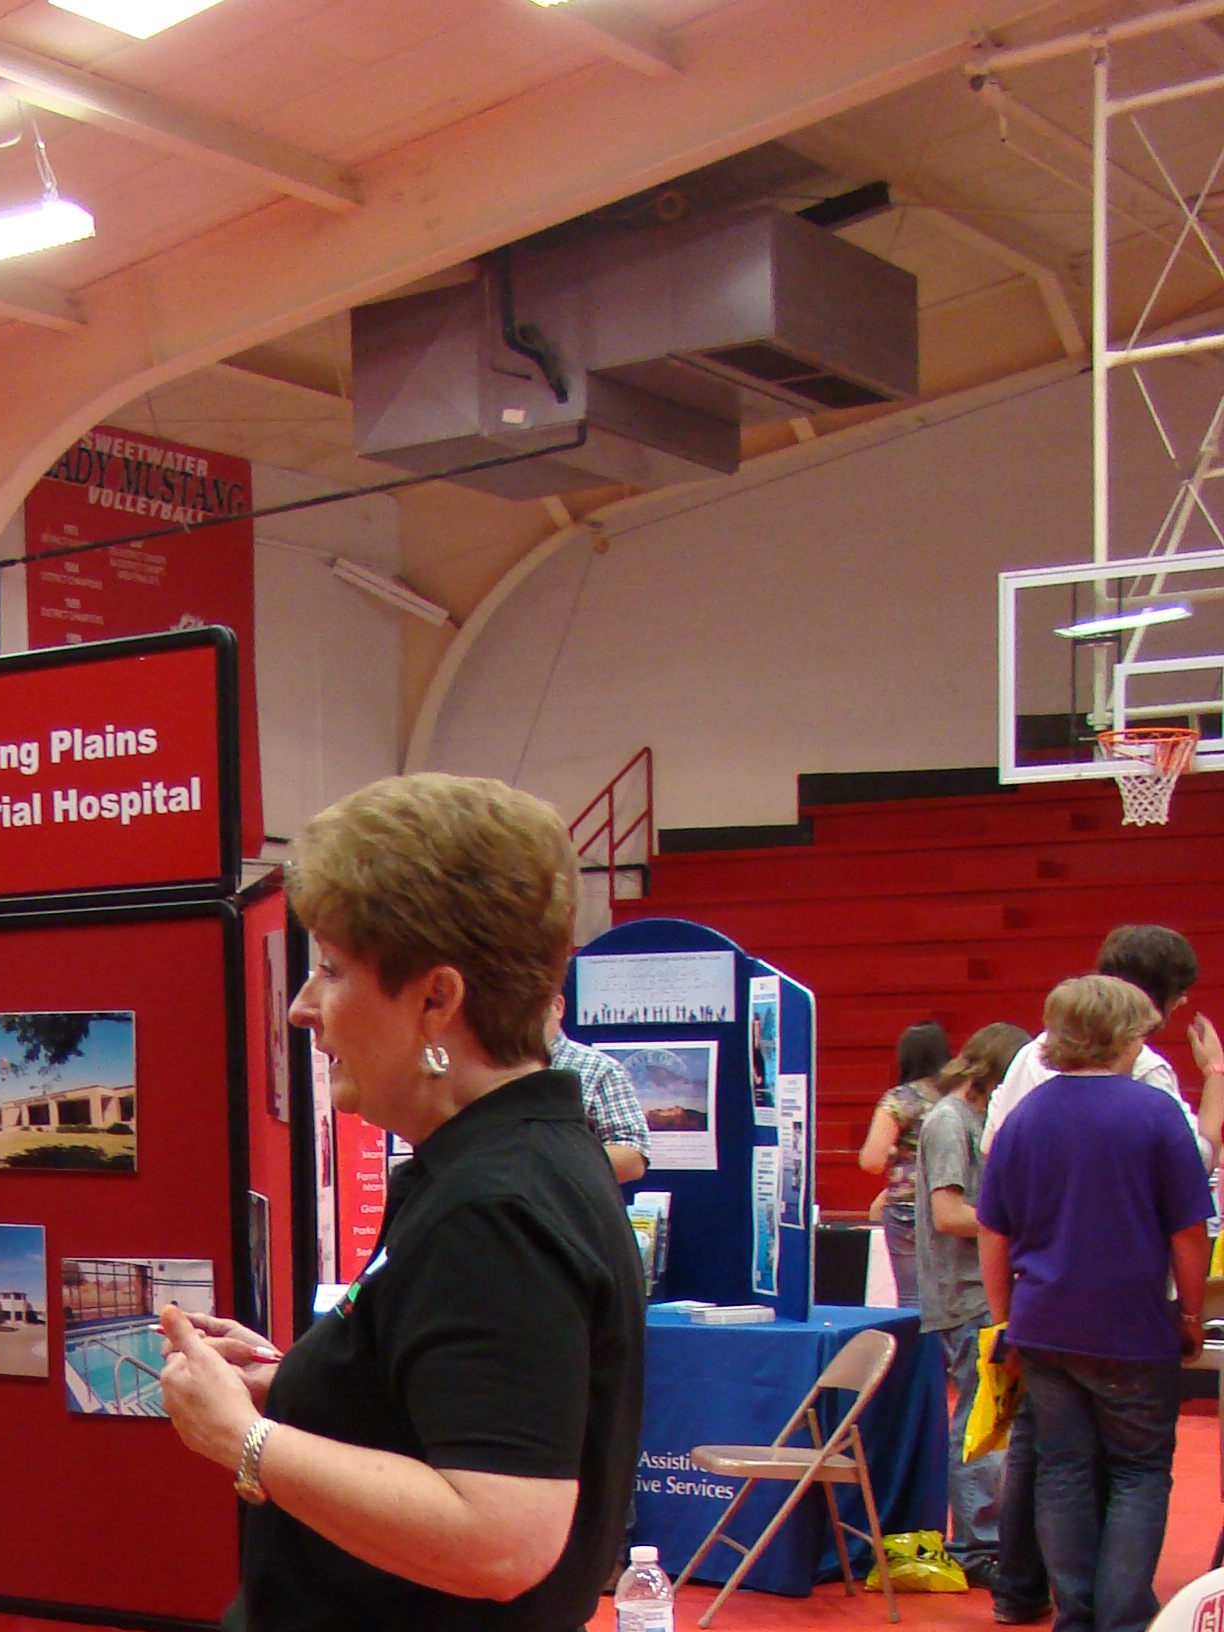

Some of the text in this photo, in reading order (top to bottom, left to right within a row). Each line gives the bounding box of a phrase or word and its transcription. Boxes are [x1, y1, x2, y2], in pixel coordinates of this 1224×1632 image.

[50, 724, 158, 764] Plains
[53, 776, 202, 825] Hospital
[666, 1475, 735, 1500] Services
